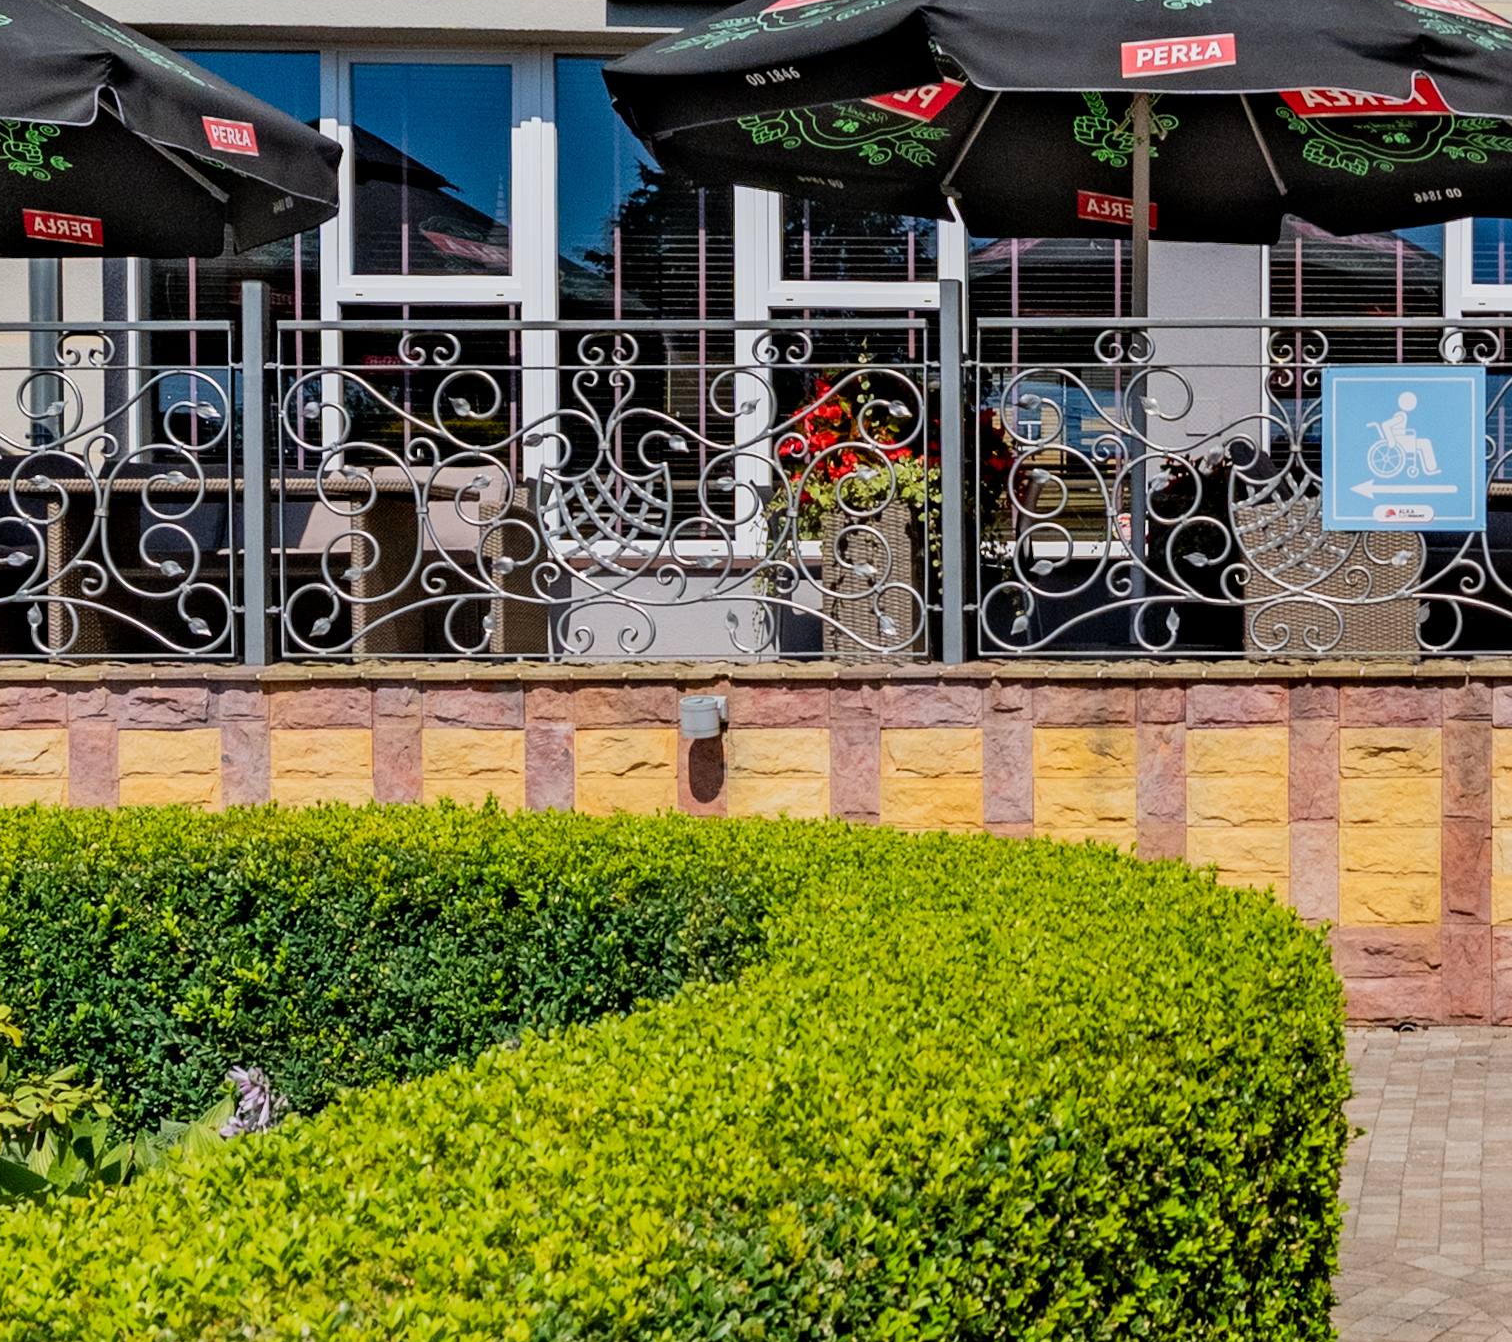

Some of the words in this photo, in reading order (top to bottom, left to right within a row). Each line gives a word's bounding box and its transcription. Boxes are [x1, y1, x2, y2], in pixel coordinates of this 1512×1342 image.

[1136, 41, 1223, 68] PERŁA
[745, 72, 767, 87] OD
[766, 66, 801, 84] 1846
[210, 123, 252, 148] PERŁA
